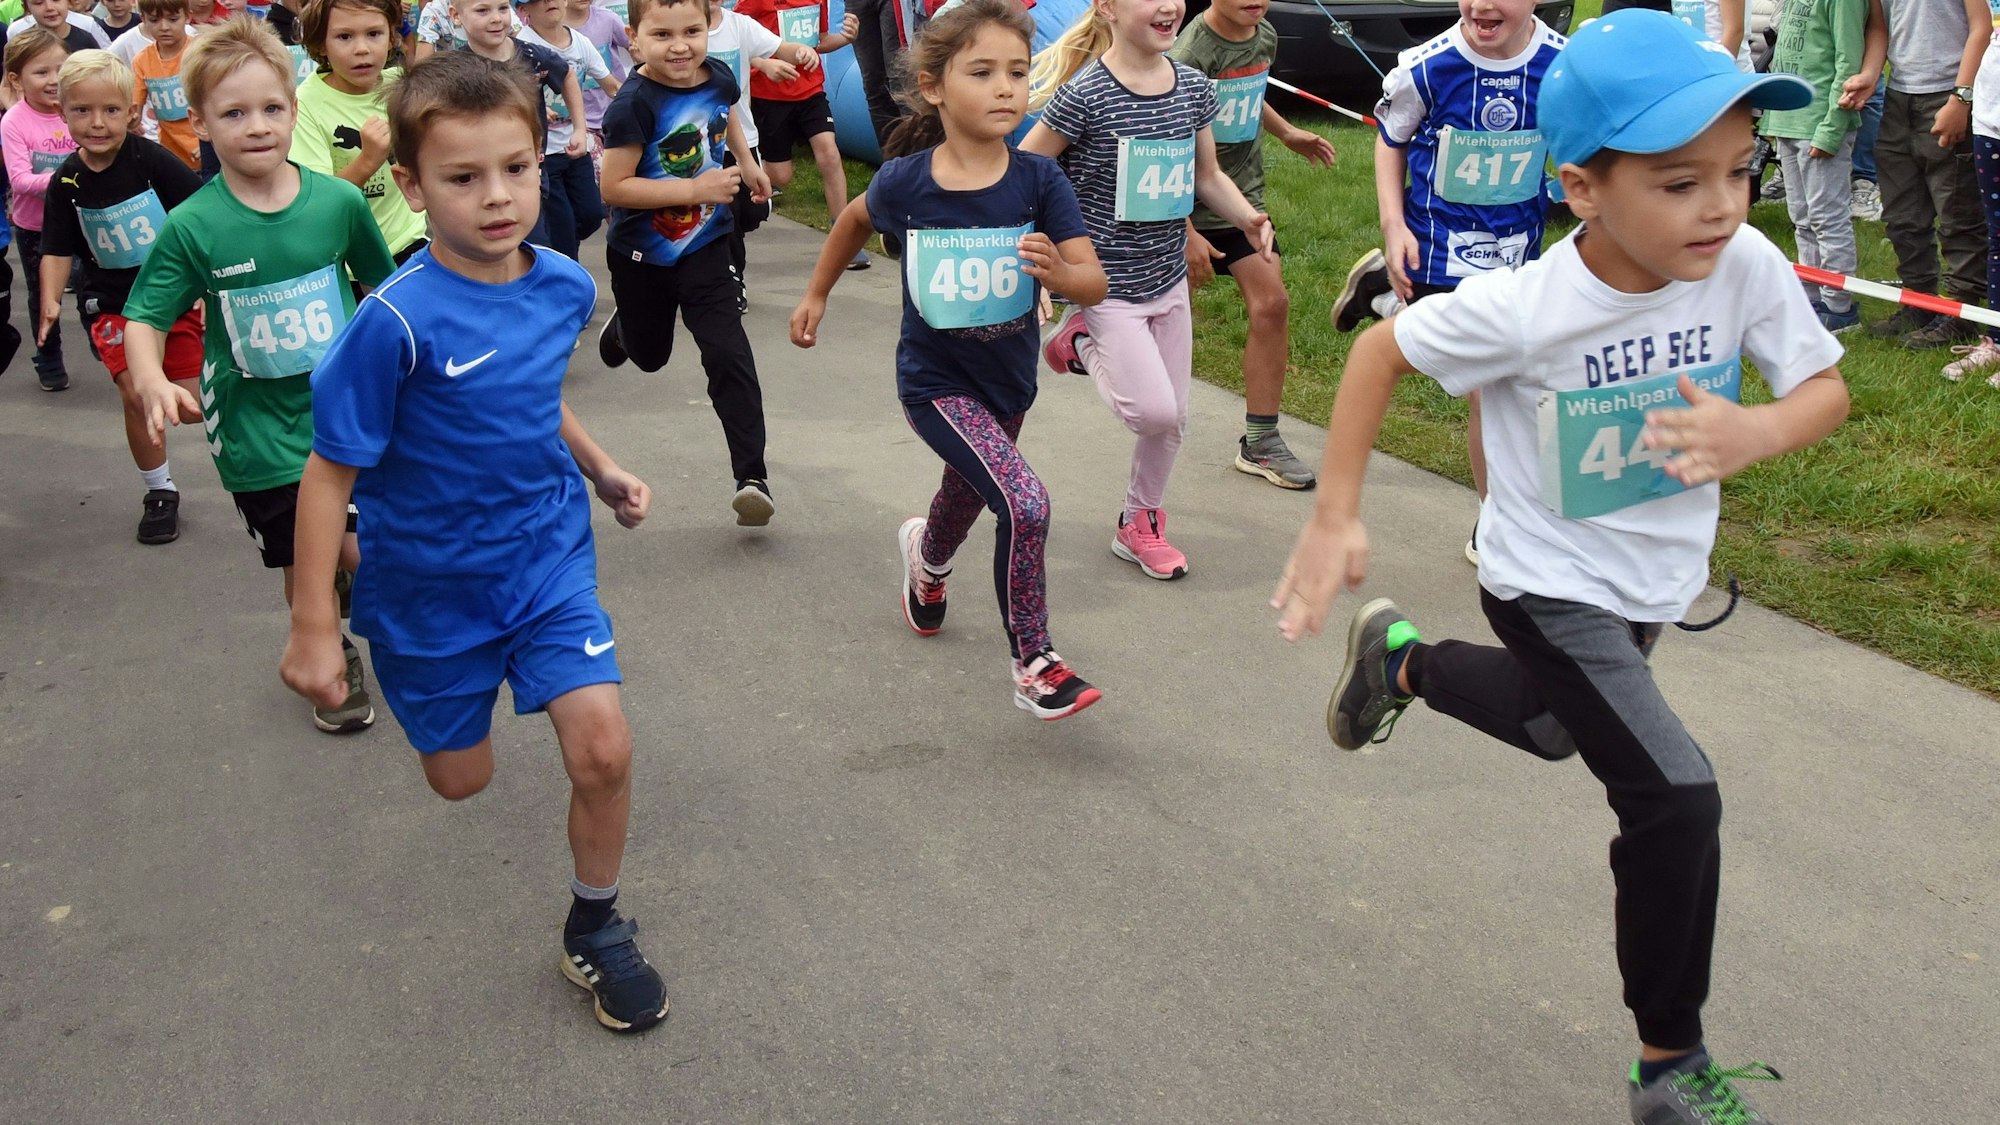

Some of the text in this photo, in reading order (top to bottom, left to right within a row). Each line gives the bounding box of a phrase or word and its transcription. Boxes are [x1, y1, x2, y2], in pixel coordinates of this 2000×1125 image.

[790, 17, 820, 39] 454
[151, 88, 188, 110] 418
[1481, 75, 1520, 88] capelli
[1216, 92, 1262, 127] 414
[1455, 151, 1532, 186] 417
[97, 215, 156, 253] 413
[232, 274, 330, 308] Wiehlparklauf
[929, 256, 1018, 302] 496
[250, 299, 333, 353] 436
[1585, 325, 1712, 388] DEEP SEE
